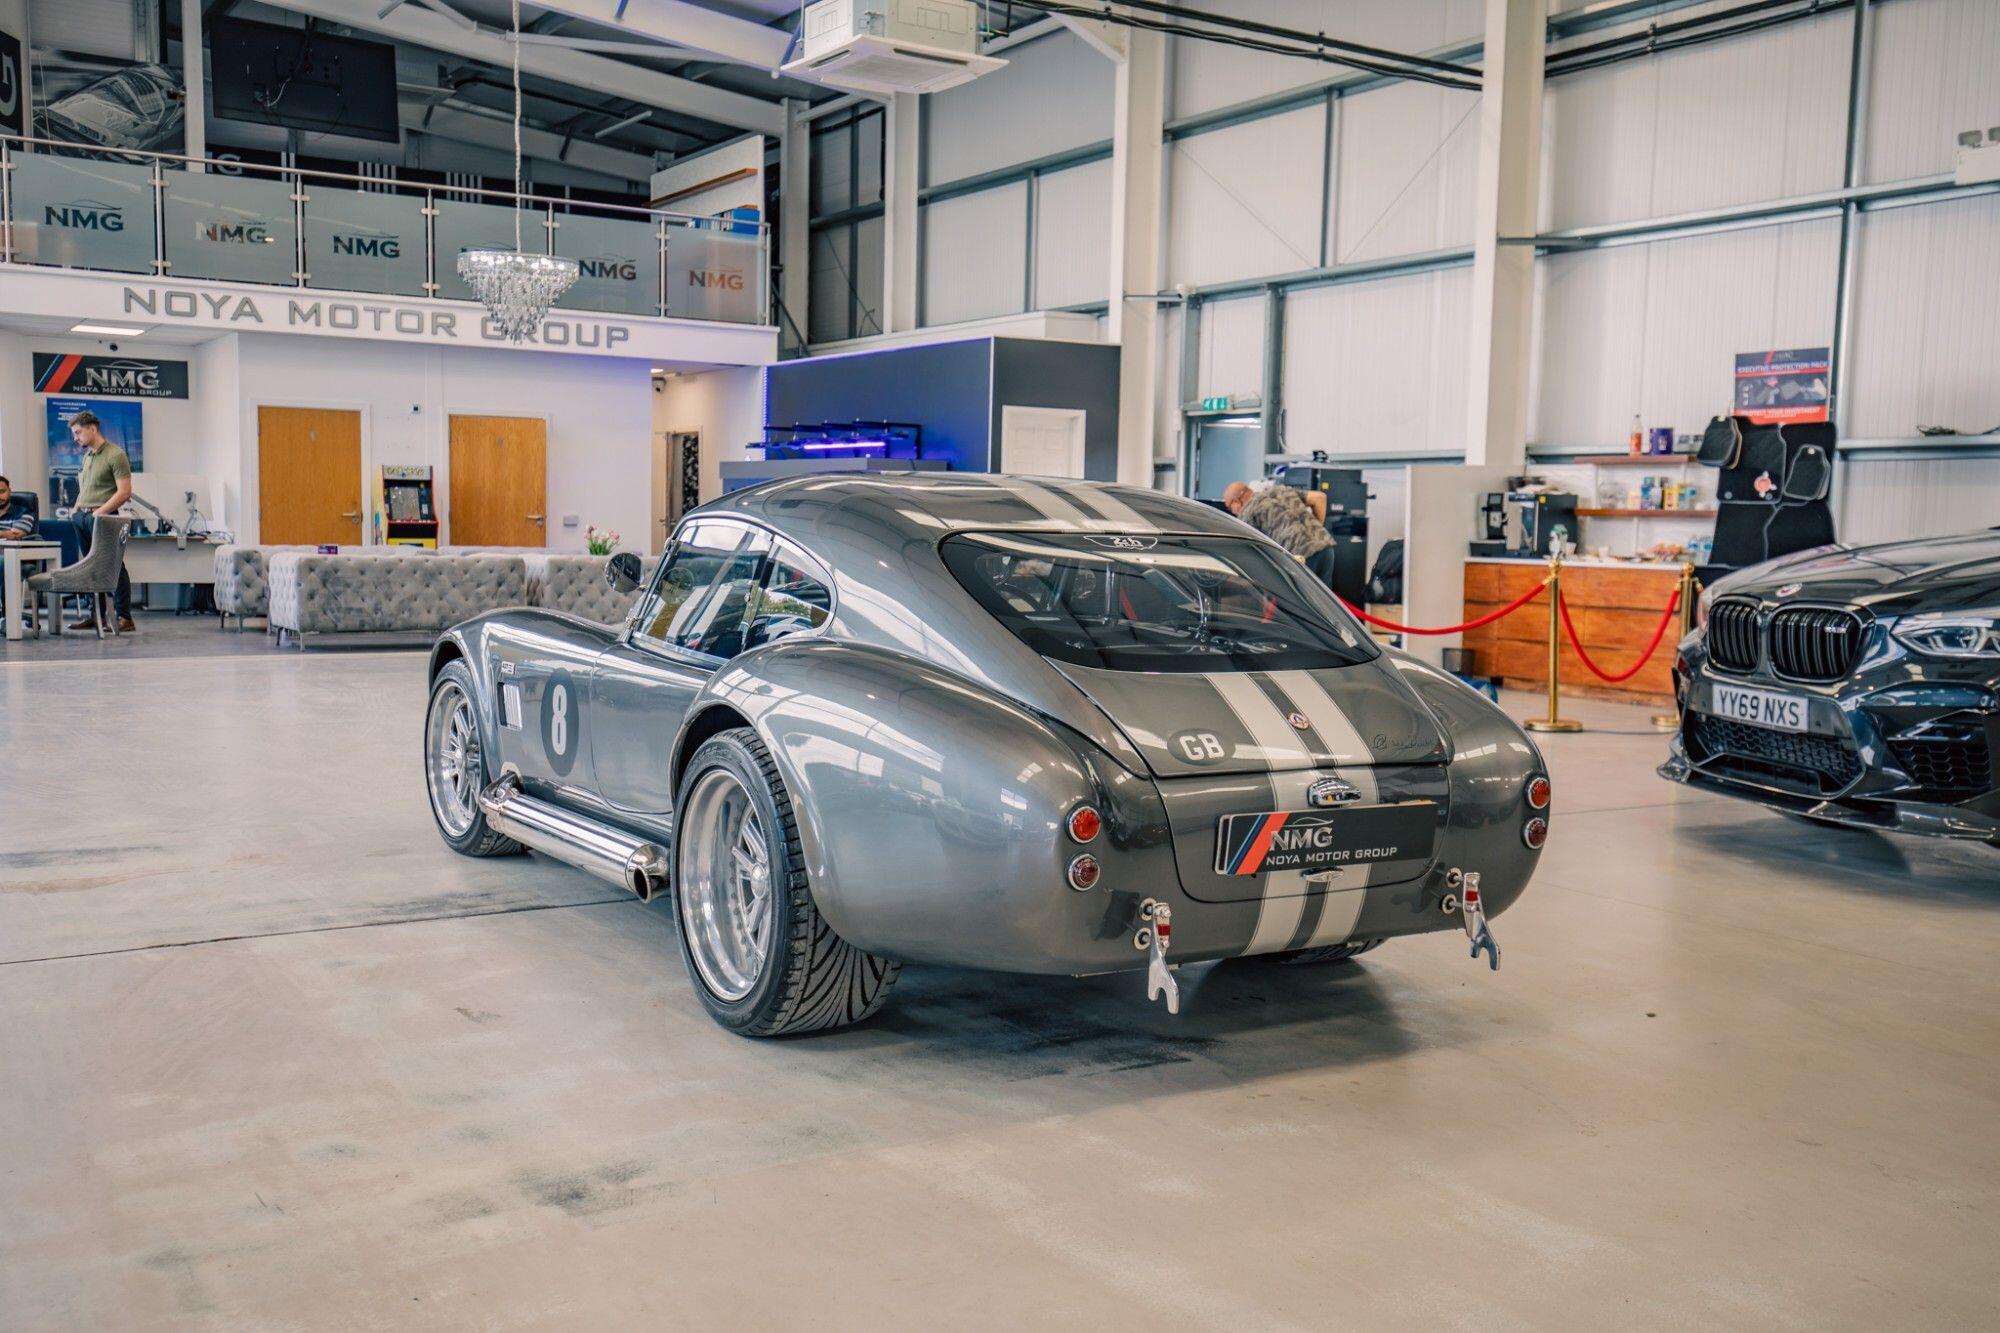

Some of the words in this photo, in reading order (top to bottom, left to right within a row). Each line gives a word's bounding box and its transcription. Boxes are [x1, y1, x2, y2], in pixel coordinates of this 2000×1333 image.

[45, 205, 124, 232] NMG
[195, 220, 268, 244] NMG
[333, 235, 400, 258] NMG
[578, 259, 637, 281] NMG
[688, 270, 744, 290] NMG
[123, 287, 263, 323] NOYA
[288, 299, 458, 337] MOTOR
[85, 367, 159, 389] NMG
[72, 385, 99, 393] NOYA
[102, 387, 136, 395] MOTOR
[139, 388, 172, 396] GROUP
[551, 684, 567, 756] 8
[1720, 690, 1760, 719] YY69
[1764, 697, 1799, 727] NXS
[1179, 732, 1225, 760] GB
[1269, 826, 1333, 851] NMG
[1266, 854, 1300, 866] NOYA
[1306, 851, 1350, 863] MOTOR
[1354, 846, 1398, 859] GROUP
